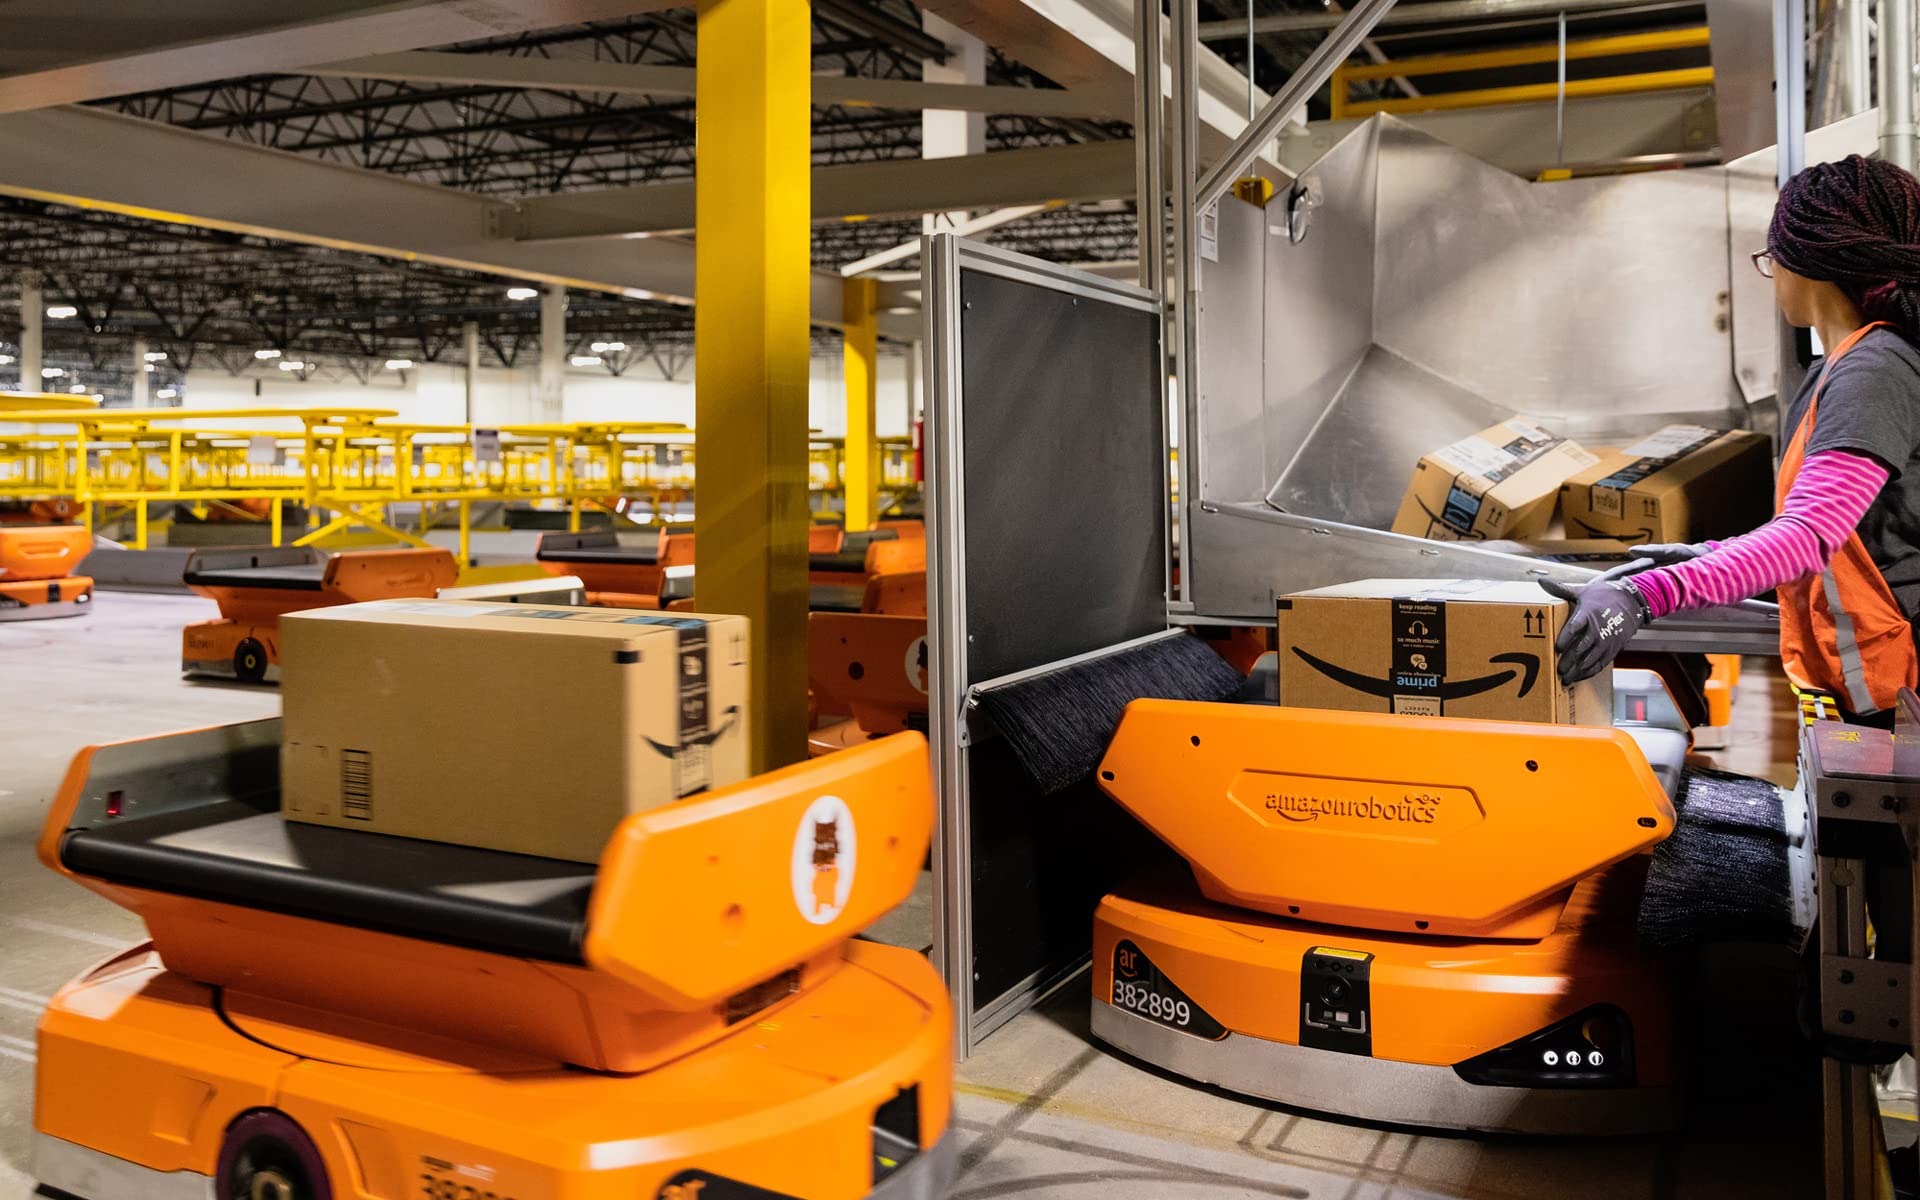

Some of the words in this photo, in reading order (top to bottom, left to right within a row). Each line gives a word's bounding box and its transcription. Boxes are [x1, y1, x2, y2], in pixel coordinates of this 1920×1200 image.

[1414, 604, 1437, 612] reading
[1397, 674, 1438, 690] prime
[1265, 793, 1437, 824] amazonrobotics
[1120, 948, 1138, 971] ar
[1114, 979, 1191, 1026] 382899
